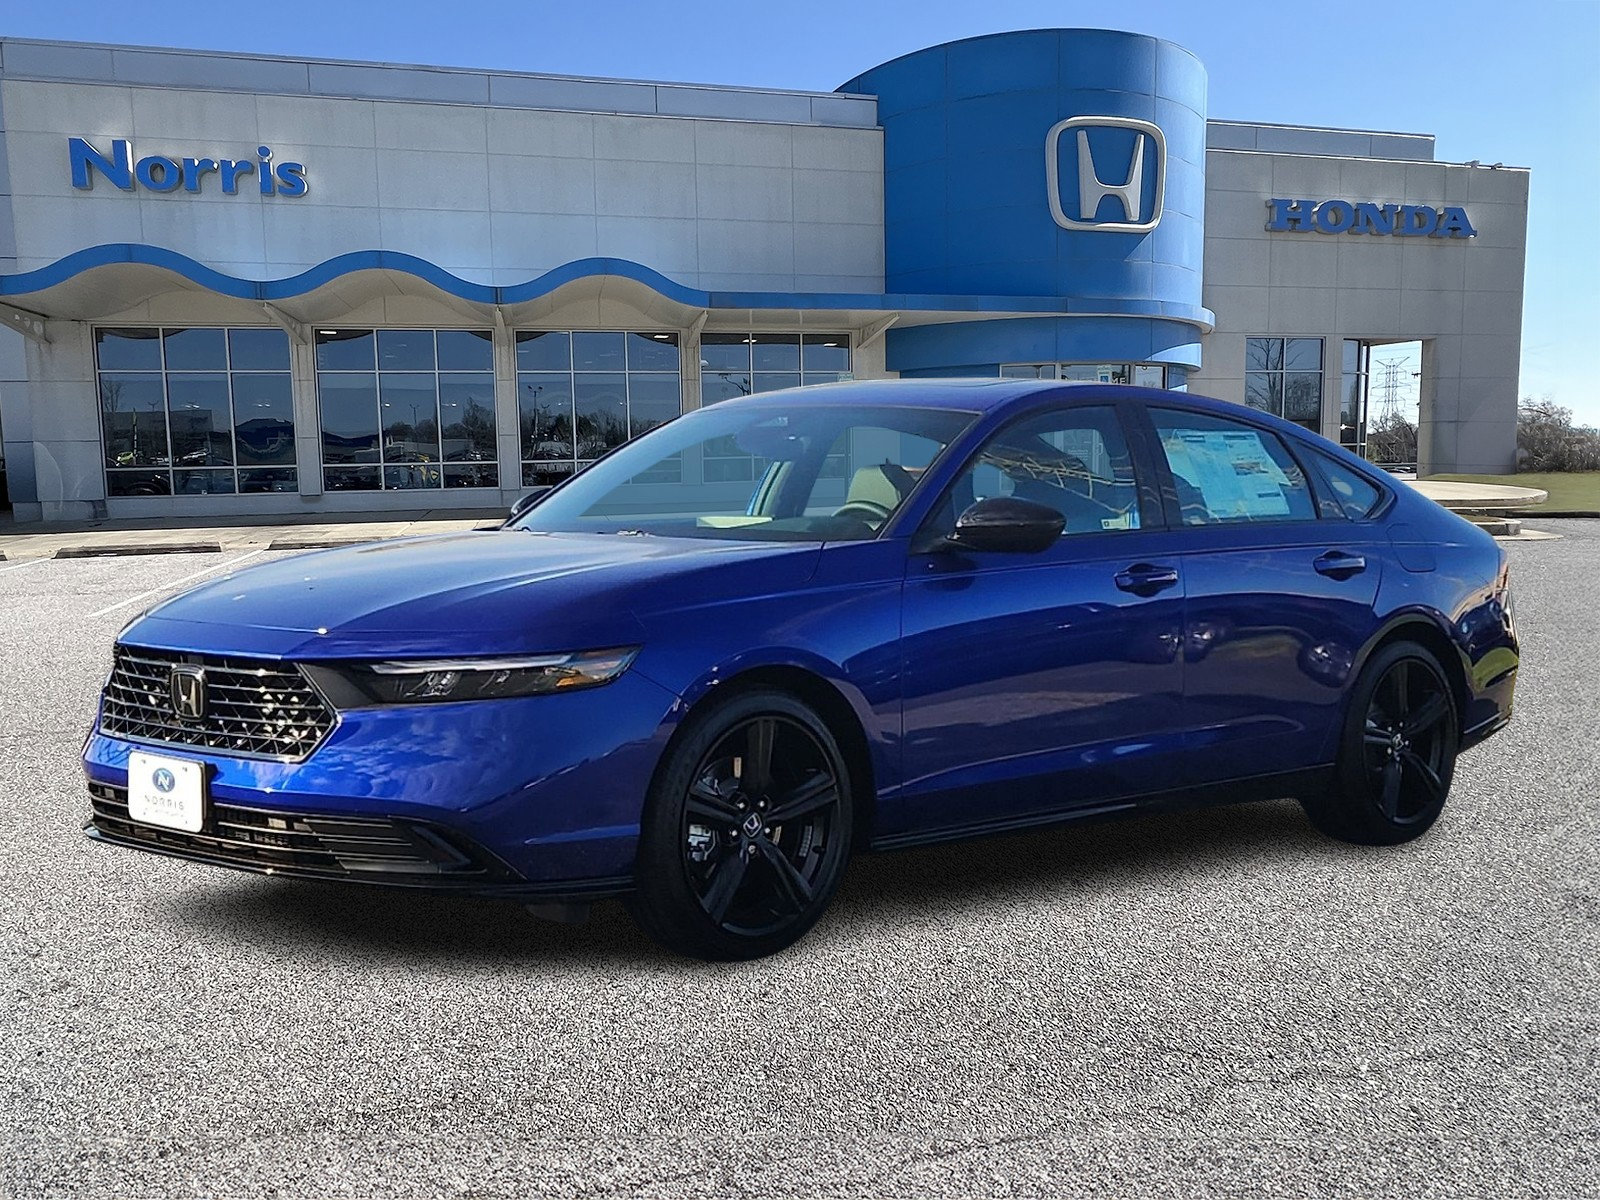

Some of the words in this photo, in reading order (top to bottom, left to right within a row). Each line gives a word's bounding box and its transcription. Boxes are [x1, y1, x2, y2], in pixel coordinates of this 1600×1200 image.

[68, 136, 309, 197] Norris
[1265, 198, 1478, 239] HONDA
[144, 794, 184, 811] NORRIS
